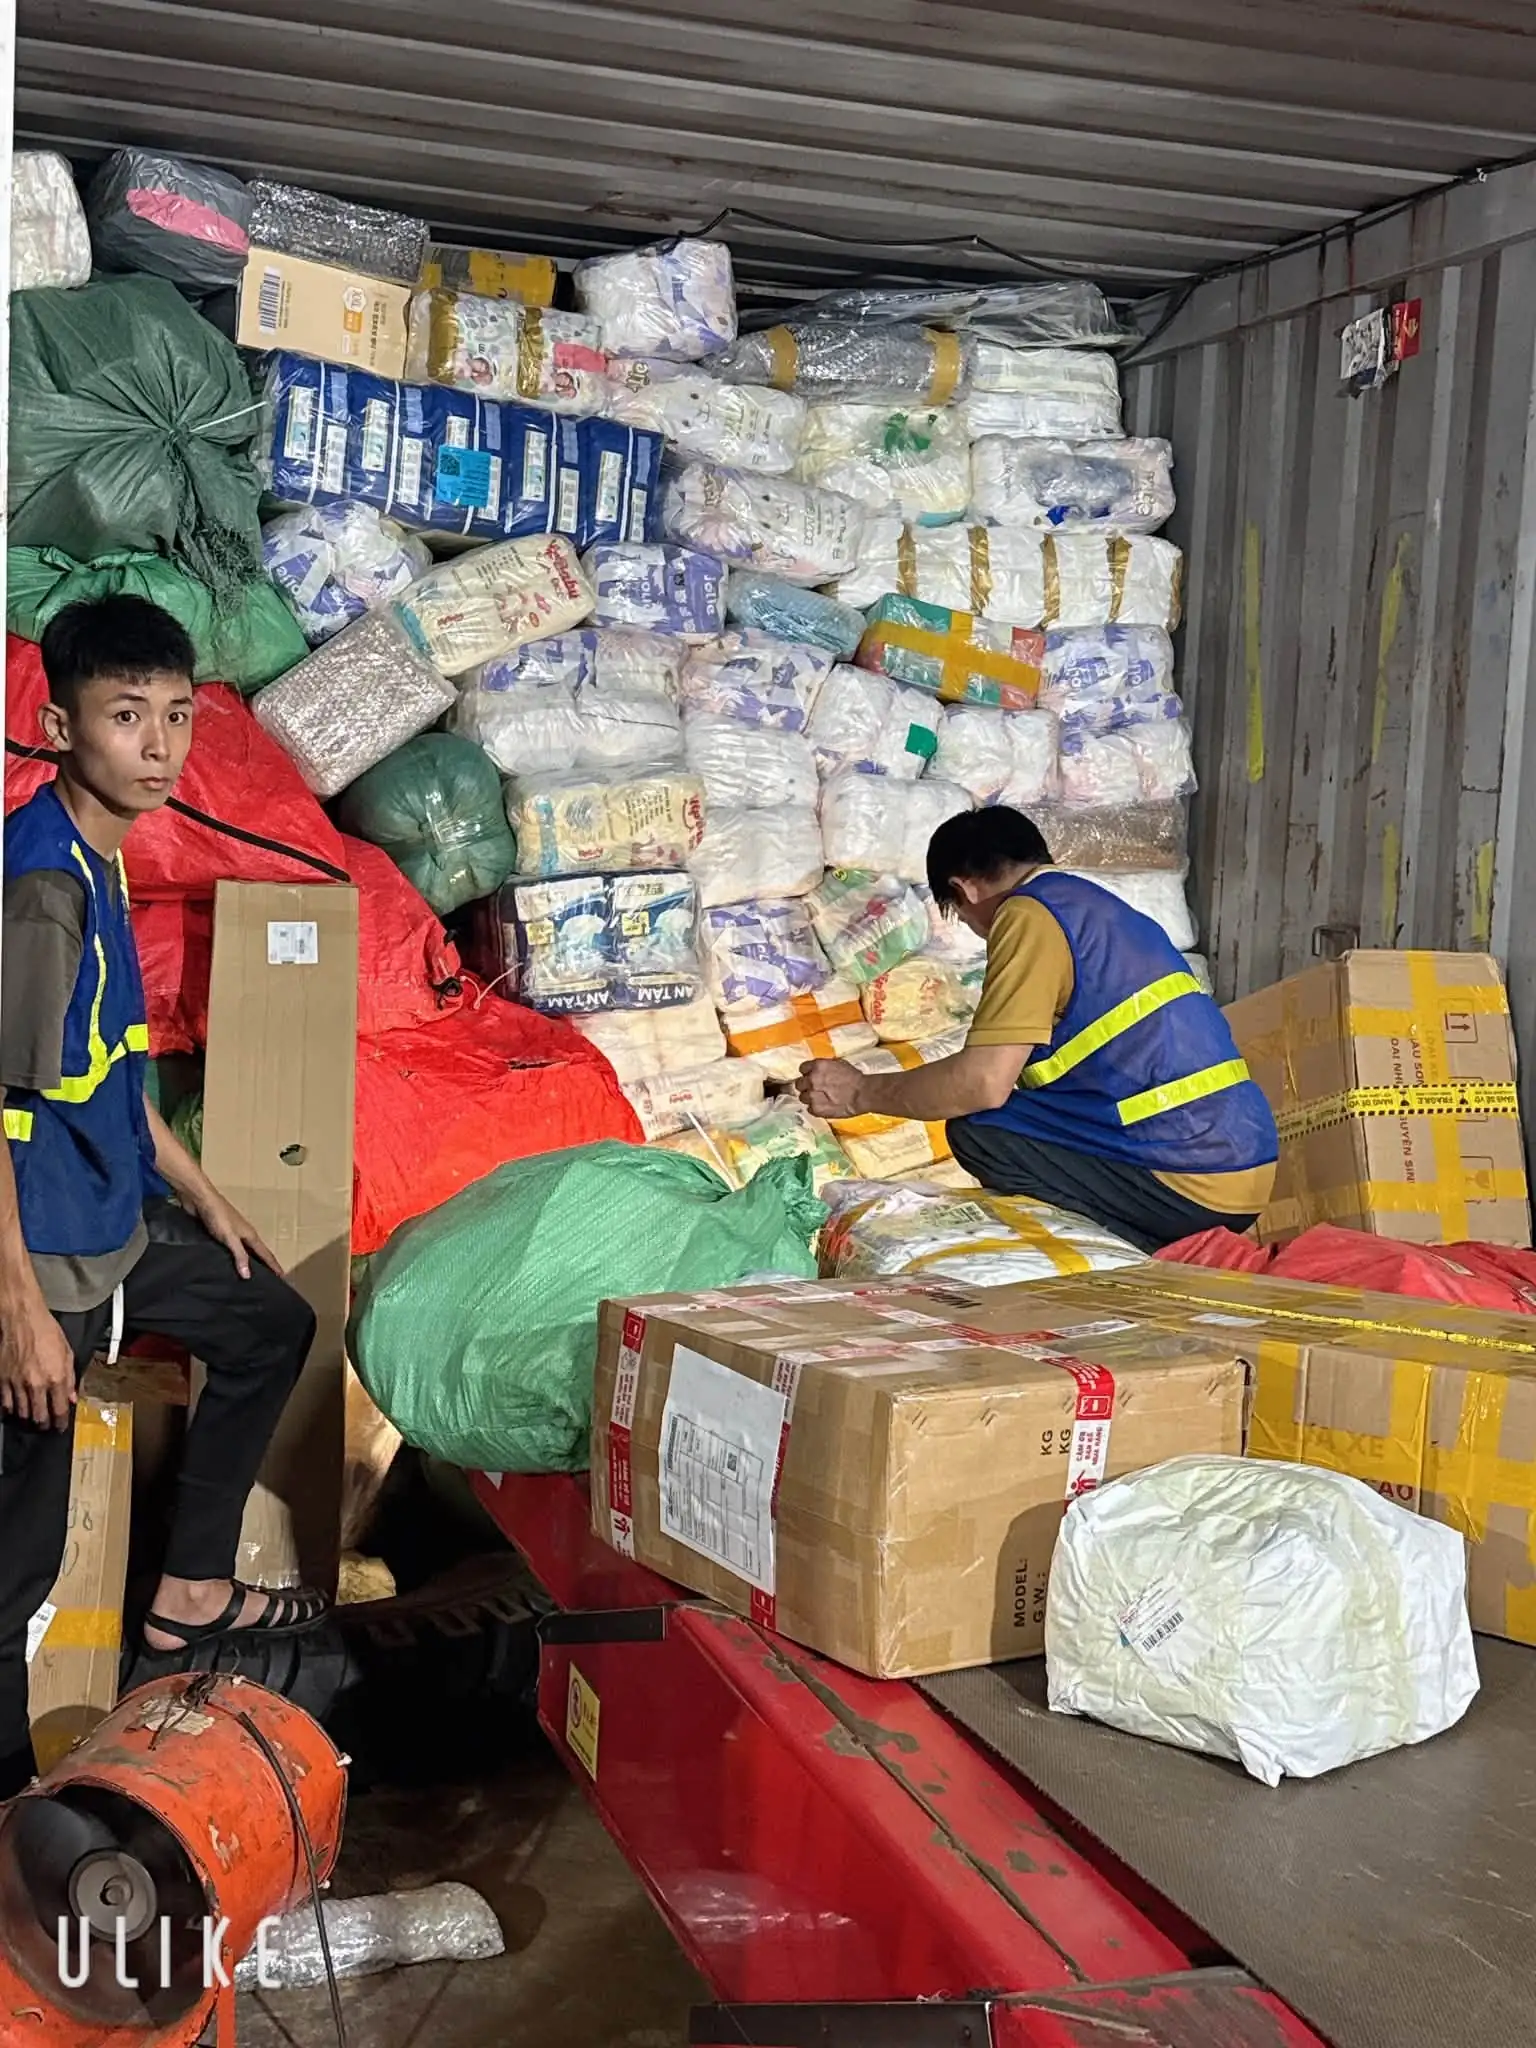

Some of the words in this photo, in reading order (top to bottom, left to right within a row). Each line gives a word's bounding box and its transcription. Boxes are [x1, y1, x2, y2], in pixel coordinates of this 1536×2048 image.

[1041, 1429, 1053, 1456] KG
[1059, 1428, 1071, 1454] KG
[1014, 1558, 1028, 1628] MODEL:
